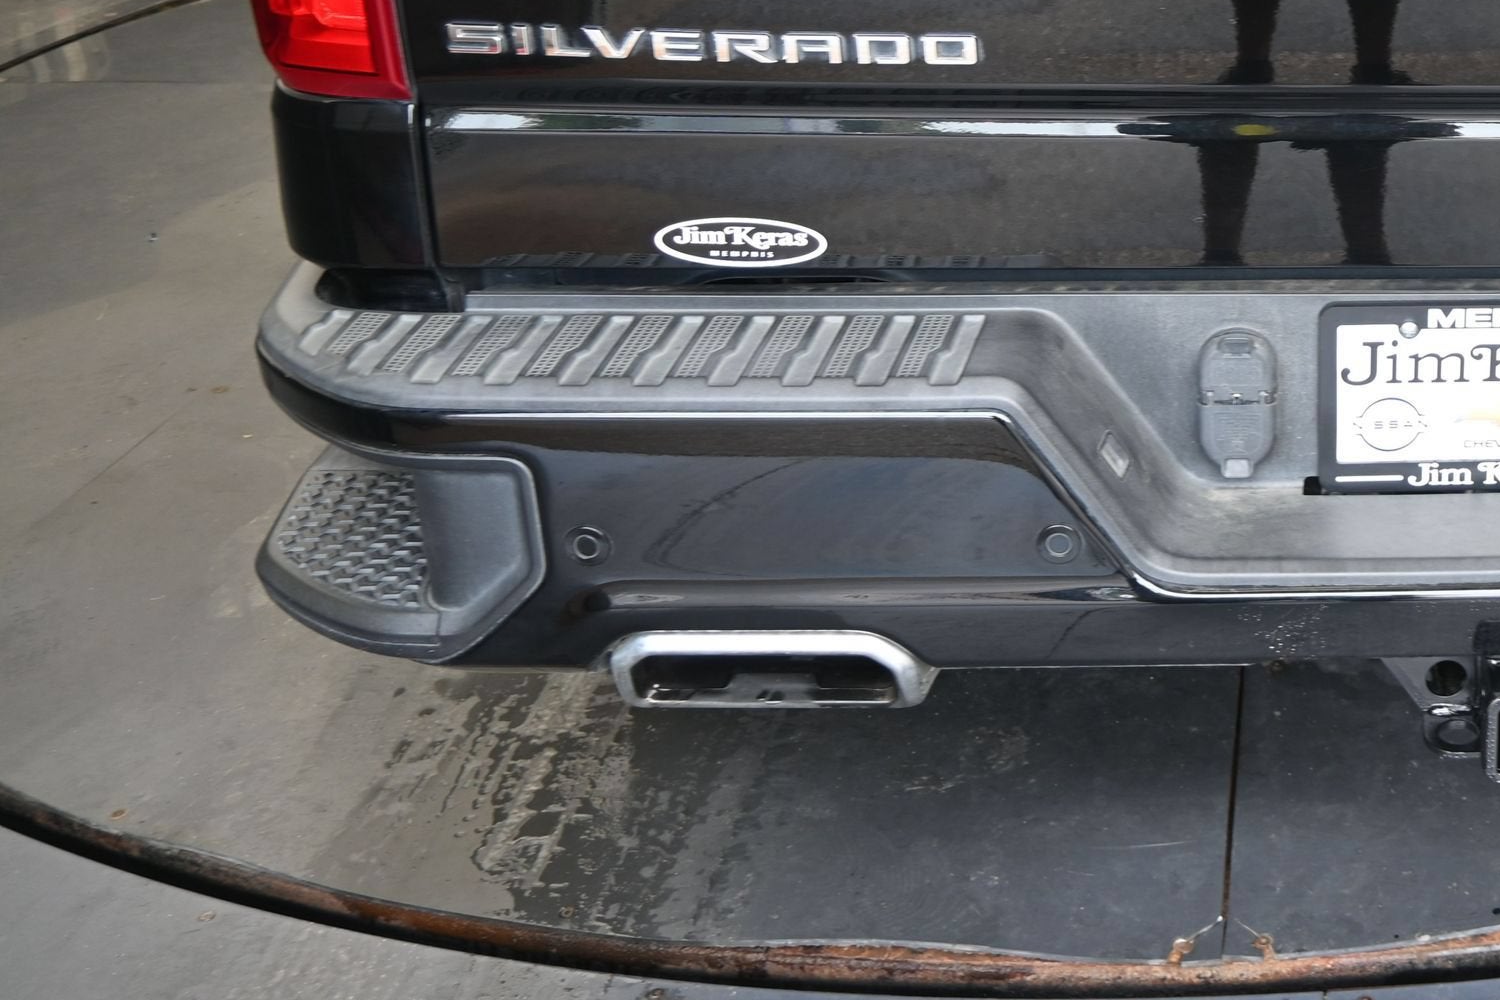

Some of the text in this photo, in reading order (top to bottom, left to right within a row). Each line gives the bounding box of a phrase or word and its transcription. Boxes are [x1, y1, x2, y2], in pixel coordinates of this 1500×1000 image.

[446, 21, 979, 66] SILVERADO
[709, 250, 775, 258] MEMPHIS
[1407, 461, 1474, 487] Jim
